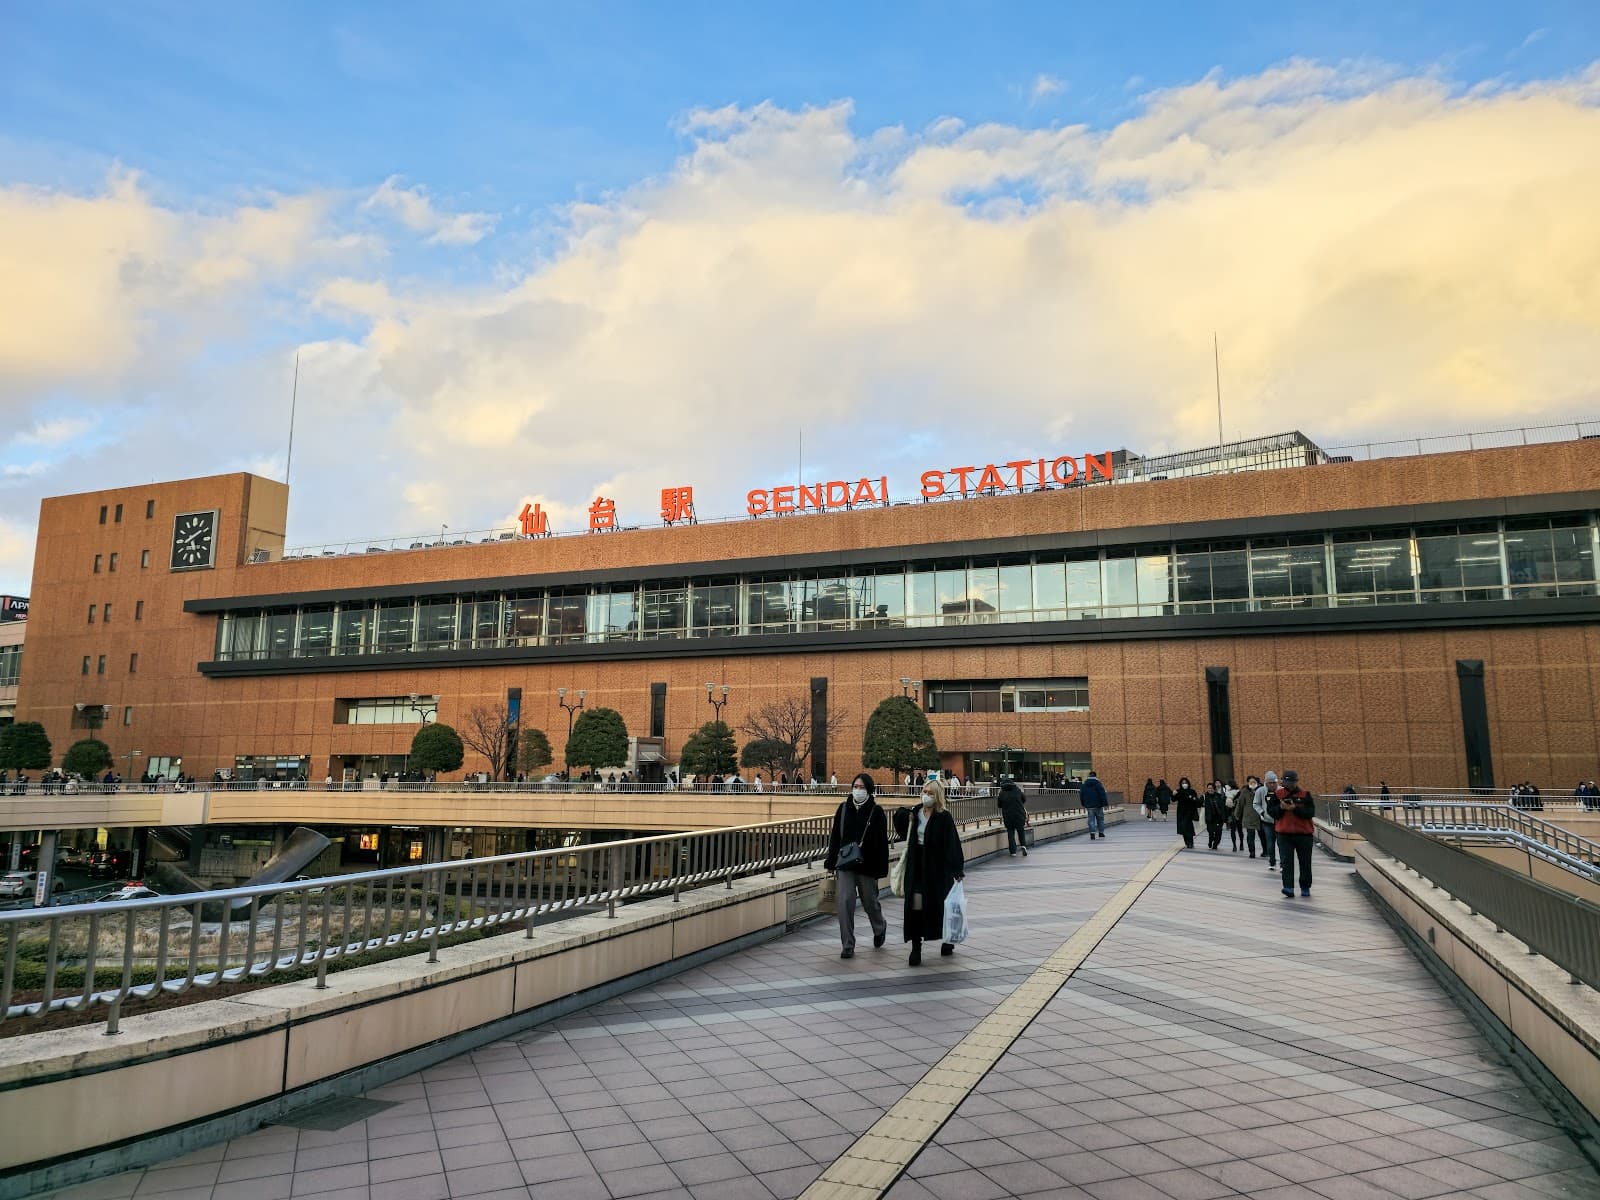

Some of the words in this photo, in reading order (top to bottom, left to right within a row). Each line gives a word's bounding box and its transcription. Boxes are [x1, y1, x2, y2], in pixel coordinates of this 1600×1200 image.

[519, 487, 692, 535] 仙台駅
[747, 476, 887, 516] SENDAI
[920, 451, 1112, 498] STATION
